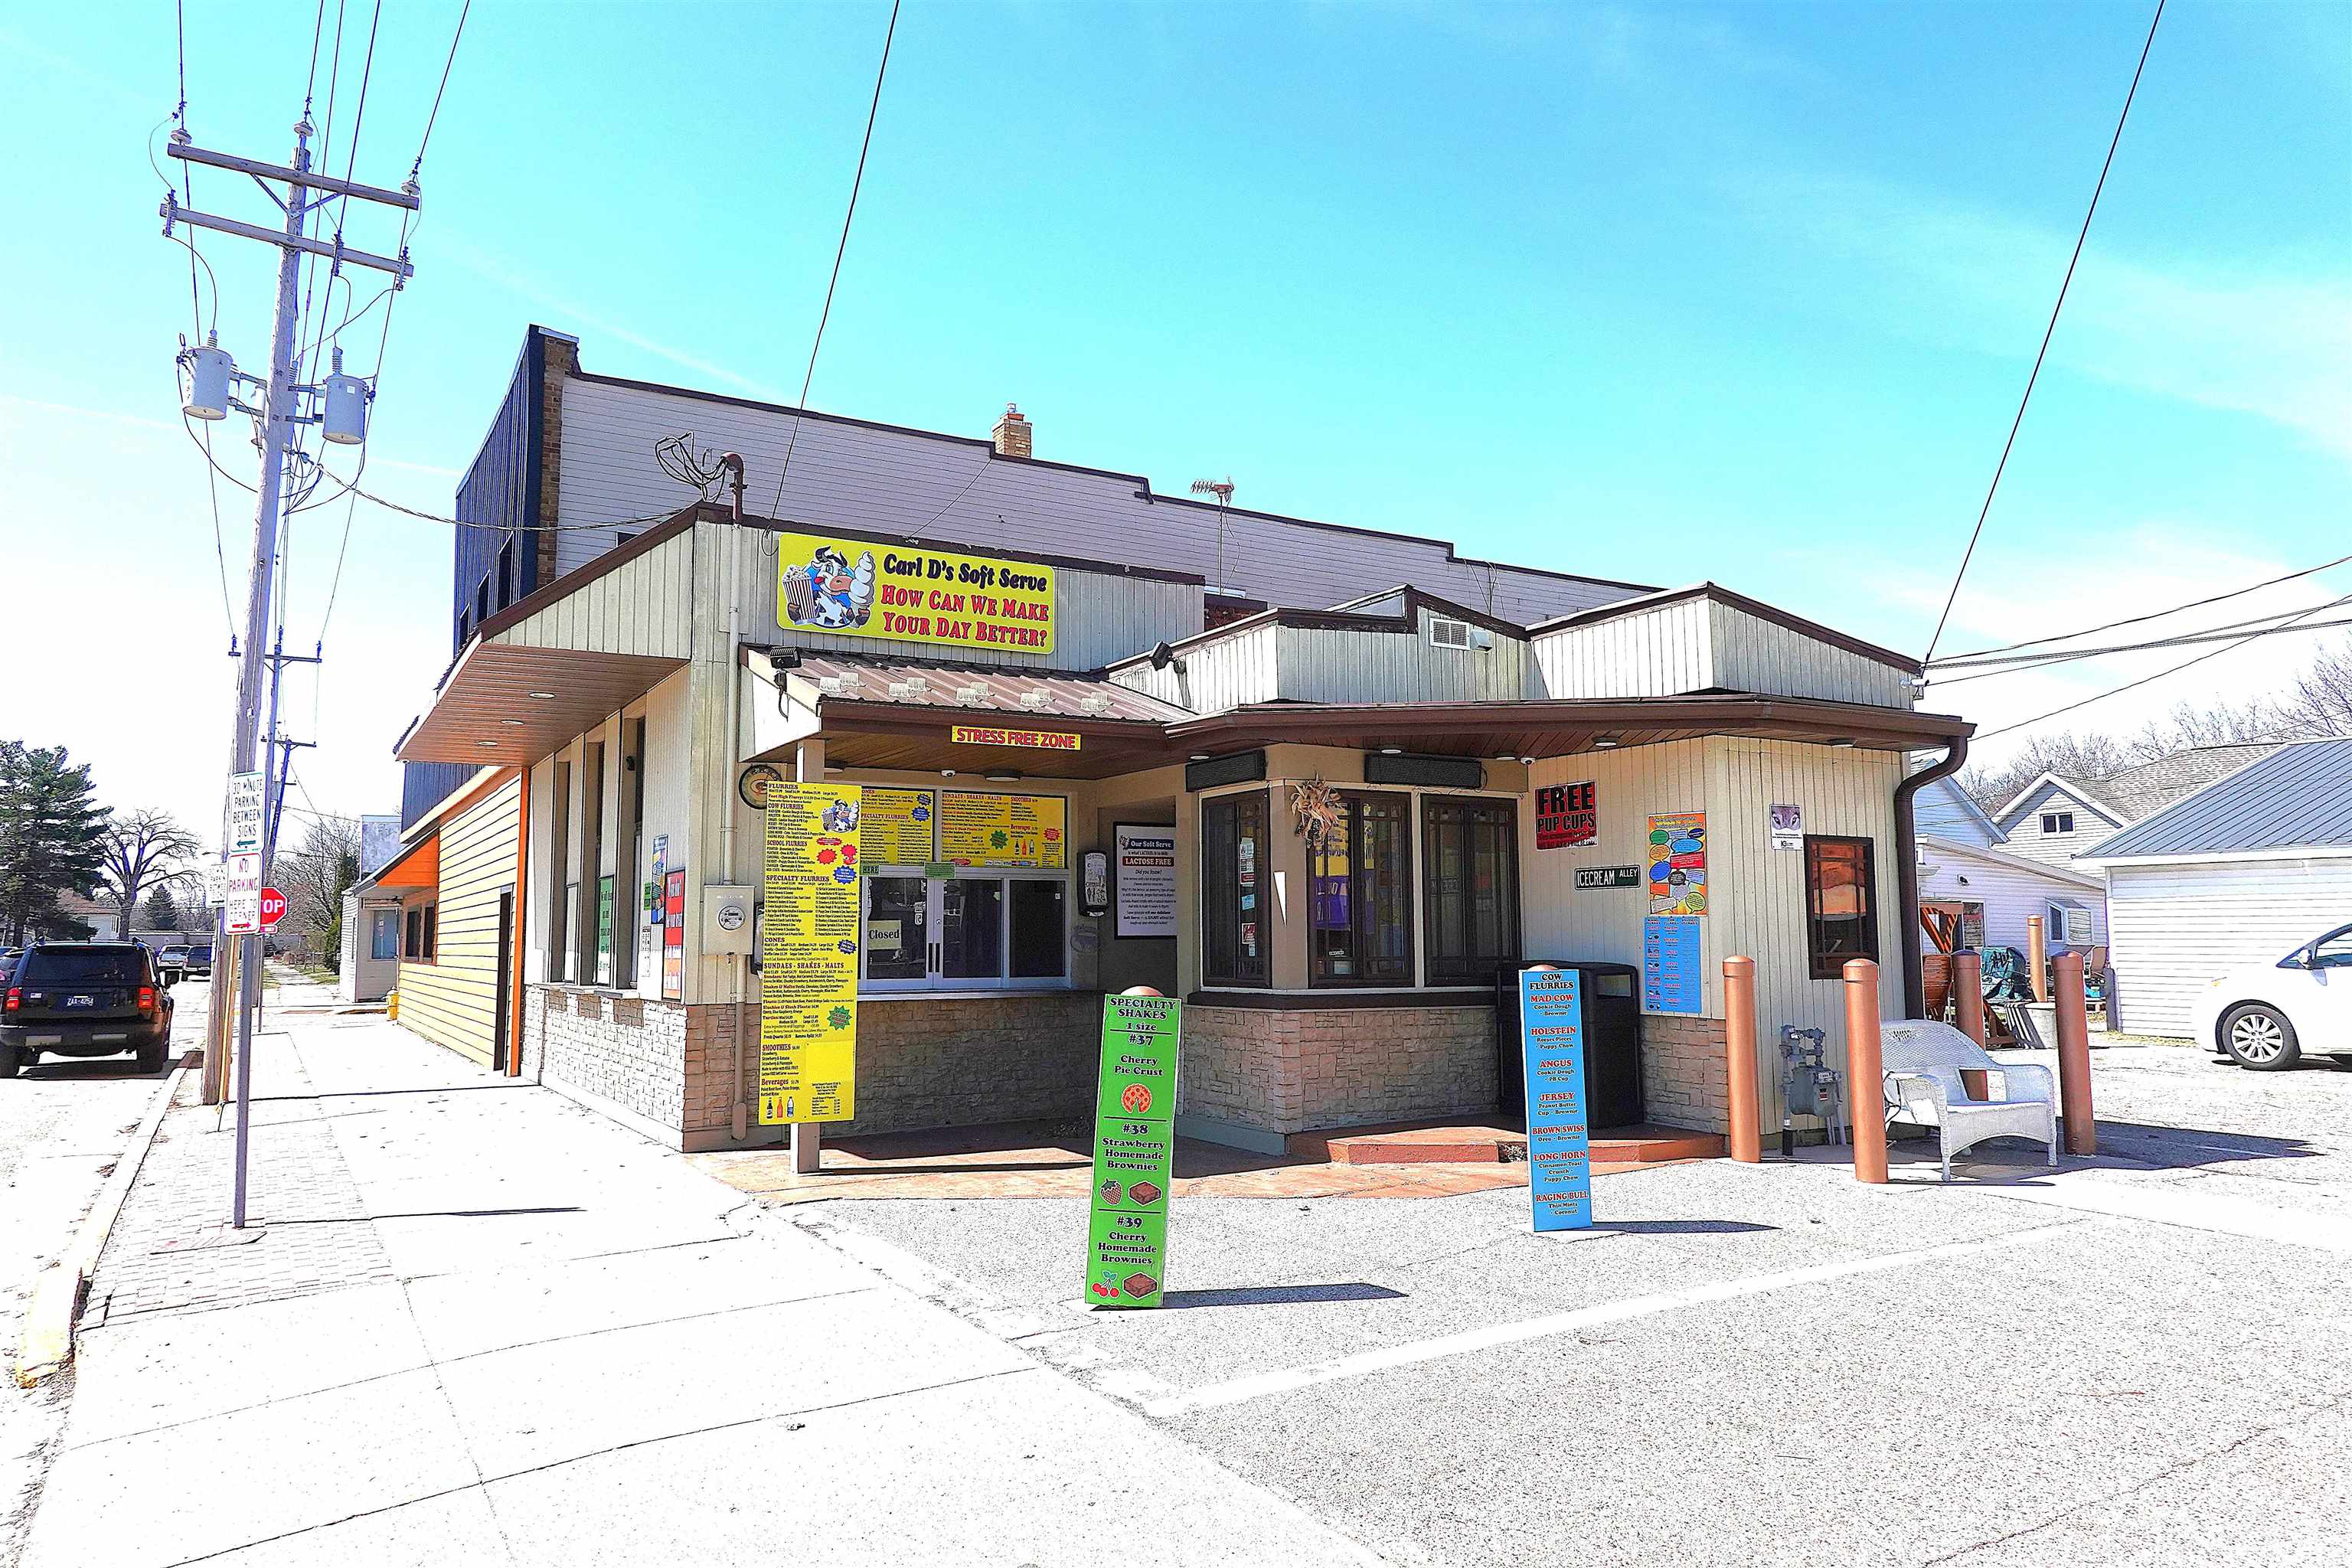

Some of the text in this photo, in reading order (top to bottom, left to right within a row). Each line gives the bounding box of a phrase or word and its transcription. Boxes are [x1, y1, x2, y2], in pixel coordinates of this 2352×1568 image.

[884, 554, 1047, 593] Carl D's Soft Serve
[881, 585, 1049, 622] HOW CAN WE MAKE
[884, 612, 1047, 648] YOUR DAY BETTER?
[957, 728, 1076, 749] STRESS FREE ZONE
[234, 779, 263, 795] 30 MINUTE
[234, 795, 260, 808] PARKING
[1537, 782, 1593, 815] FREE
[233, 808, 261, 824] BETWEEN
[1537, 812, 1595, 833] PUP CUPS
[237, 825, 256, 838] SIGNS
[239, 858, 250, 873] NO
[863, 865, 879, 874] HERE
[1577, 868, 1638, 887] ICECREAM ALLEY
[229, 877, 258, 893] PARKING
[261, 899, 284, 914] OP
[869, 929, 900, 940] Closed
[1109, 998, 1176, 1010] SPECIALTY
[1118, 1008, 1167, 1020] SHAKES
[1135, 1022, 1157, 1031] size
[1530, 1027, 1576, 1036] HOLSTEIN
[1129, 1034, 1154, 1047] #37
[1121, 1055, 1158, 1067] Cherry
[1540, 1060, 1572, 1068] ANGUS
[1114, 1065, 1163, 1076] Pie Crust
[1539, 1093, 1574, 1101] JERSEY
[1122, 1123, 1148, 1135] #38
[1532, 1125, 1585, 1135] BROWN SWISS
[1102, 1138, 1165, 1149] Strawberry
[1105, 1149, 1164, 1160] Homemade
[1534, 1151, 1586, 1161] LONG HORN
[1107, 1161, 1158, 1171] Brownies
[1536, 1191, 1589, 1202] RAGING BULL
[1116, 1216, 1143, 1228] #39
[1109, 1232, 1148, 1243] Cherry
[1098, 1243, 1157, 1253] Homemade
[1101, 1254, 1152, 1265] Brownies
